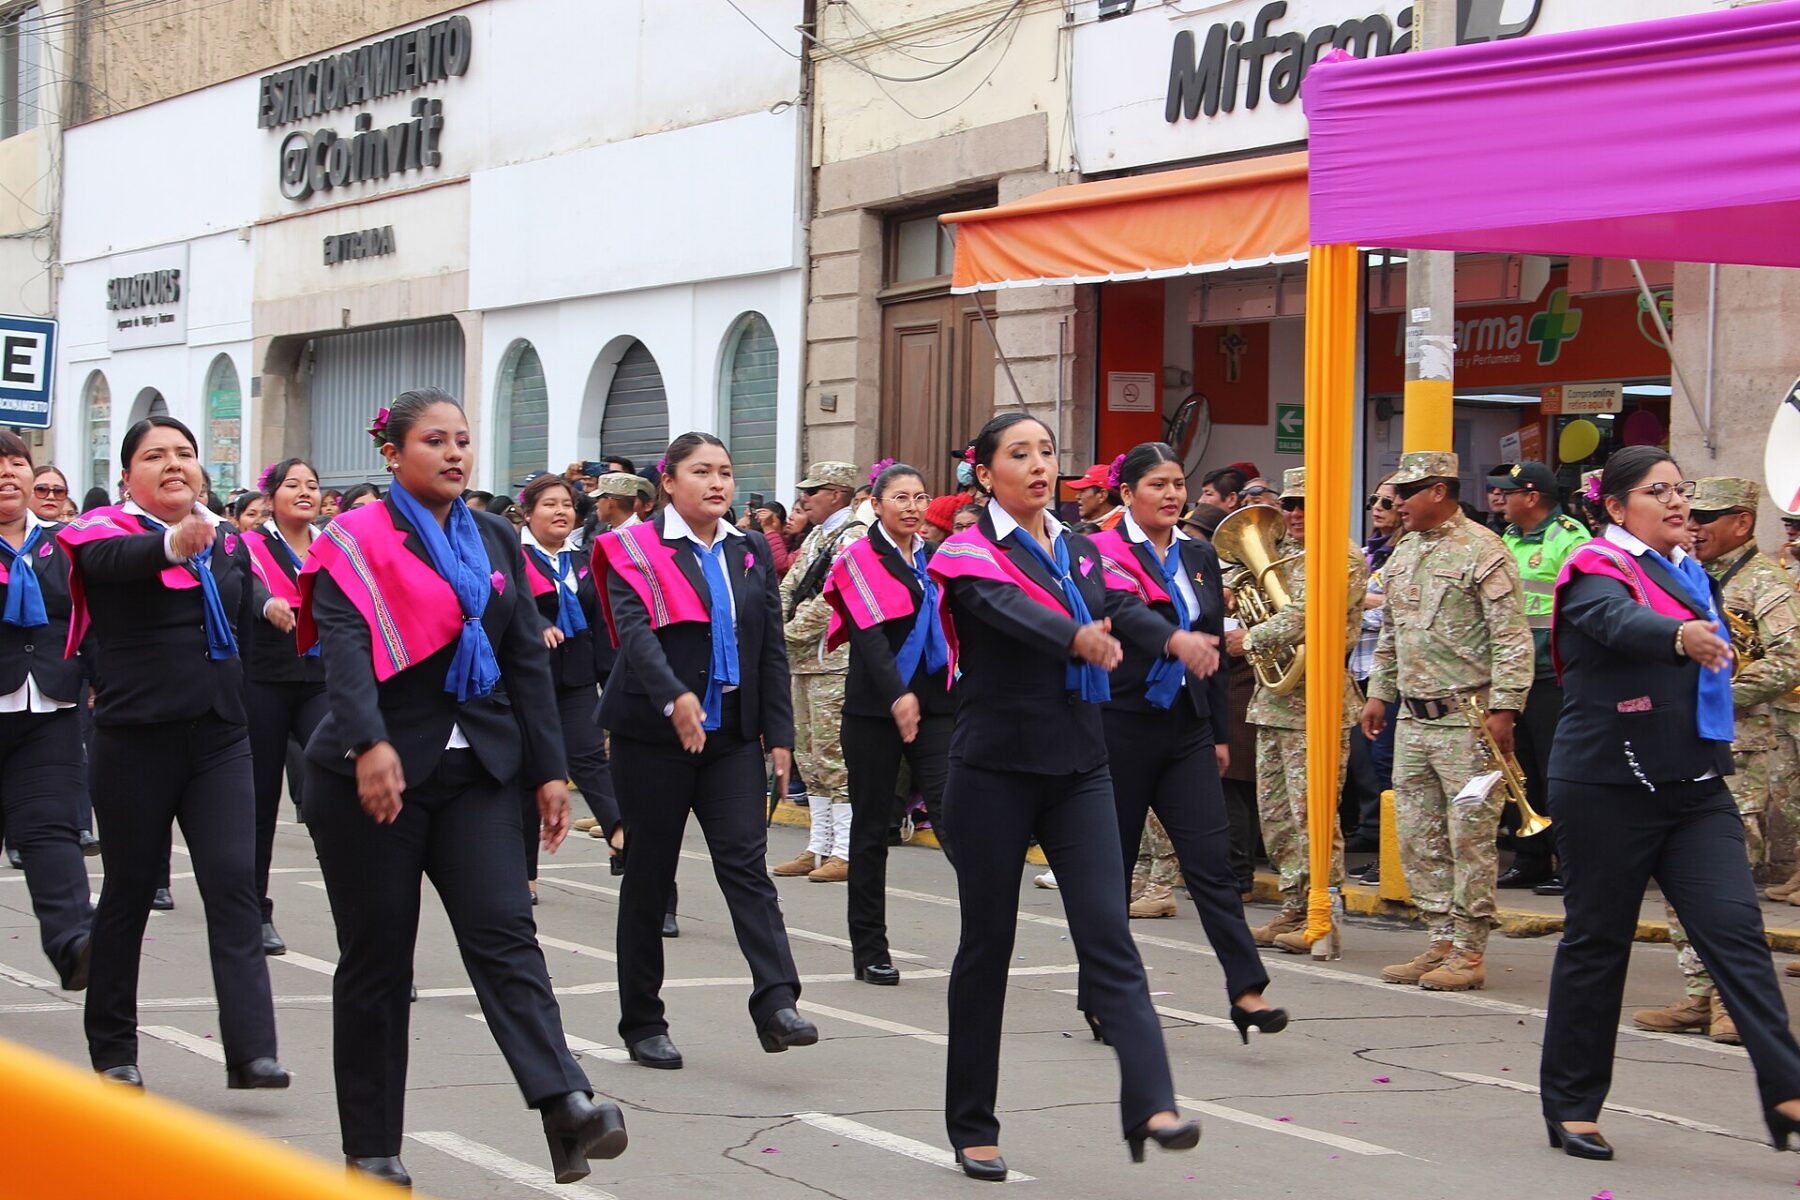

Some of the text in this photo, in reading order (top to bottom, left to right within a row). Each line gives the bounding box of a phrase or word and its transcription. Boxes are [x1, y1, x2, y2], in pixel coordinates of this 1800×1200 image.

[258, 14, 472, 129] ESTACIONAMIENTO
[323, 225, 396, 267] ENTRADA
[106, 269, 180, 311] SAMATOURS
[3, 336, 38, 383] E
